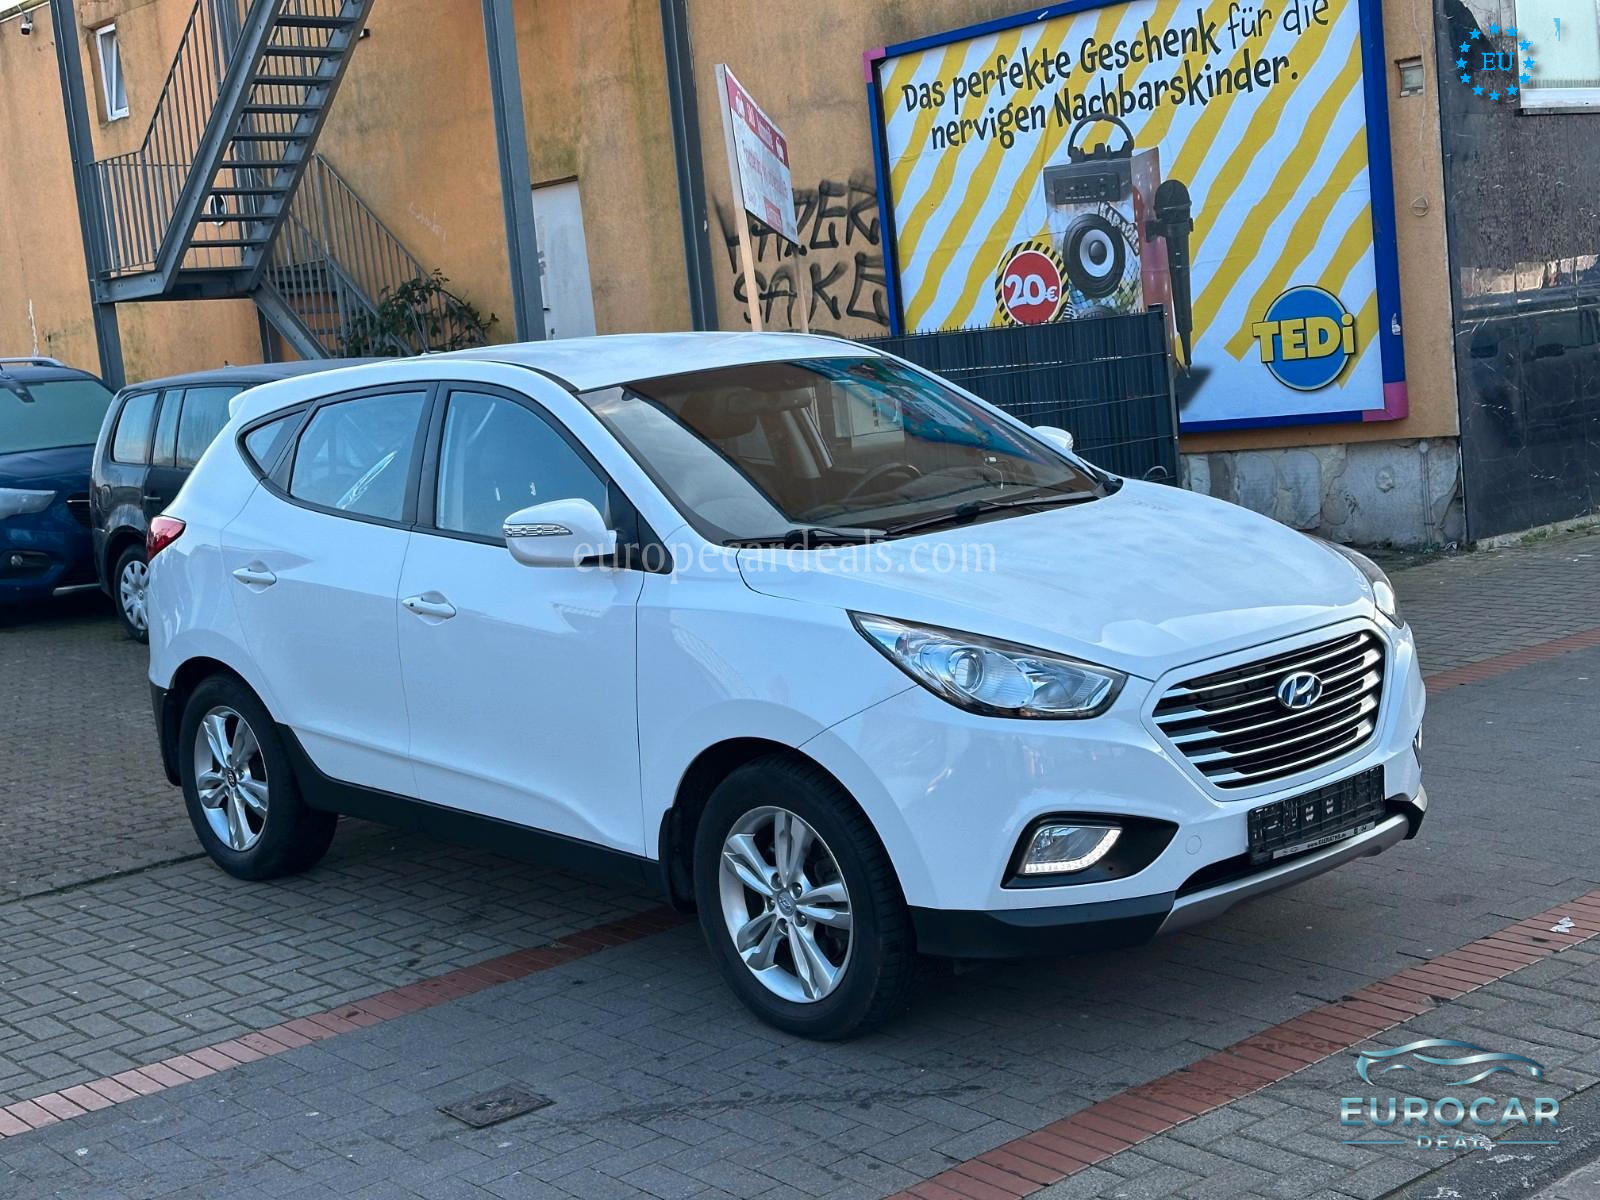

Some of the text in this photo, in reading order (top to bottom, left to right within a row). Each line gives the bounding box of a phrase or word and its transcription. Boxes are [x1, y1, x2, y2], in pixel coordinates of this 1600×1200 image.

[902, 0, 1329, 113] Das perfekte Geschenk für die
[931, 49, 1299, 150] nervigen Nachbarskinder.
[1005, 274, 1058, 309] 20€
[1252, 311, 1357, 364] TEDi
